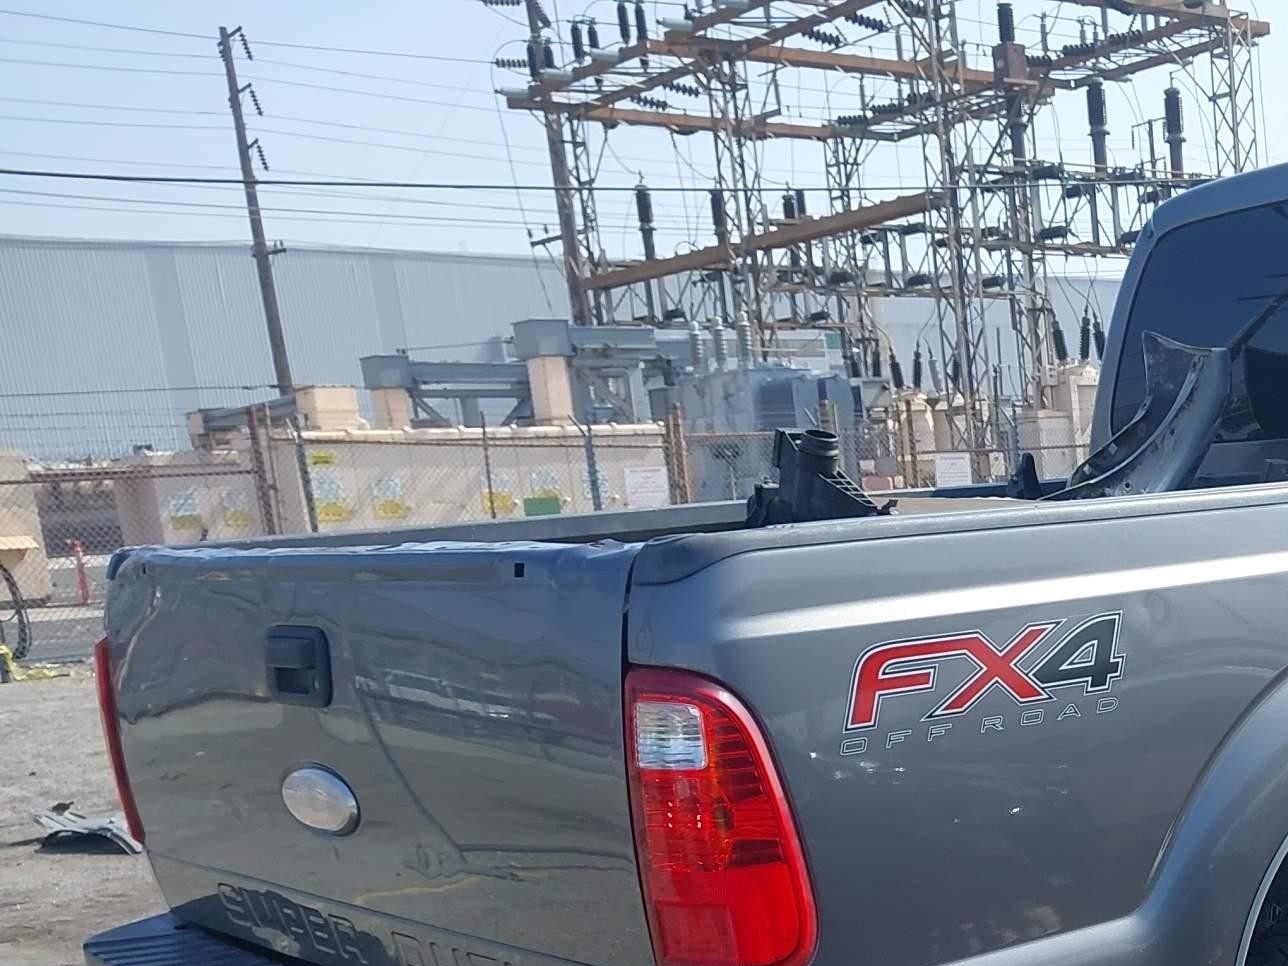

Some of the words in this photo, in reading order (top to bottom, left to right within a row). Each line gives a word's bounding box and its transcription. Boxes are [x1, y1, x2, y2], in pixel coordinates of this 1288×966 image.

[843, 610, 1126, 735] FX4
[840, 722, 953, 757] OFF
[980, 695, 1121, 734] ROAD
[216, 881, 369, 966] SUPER
